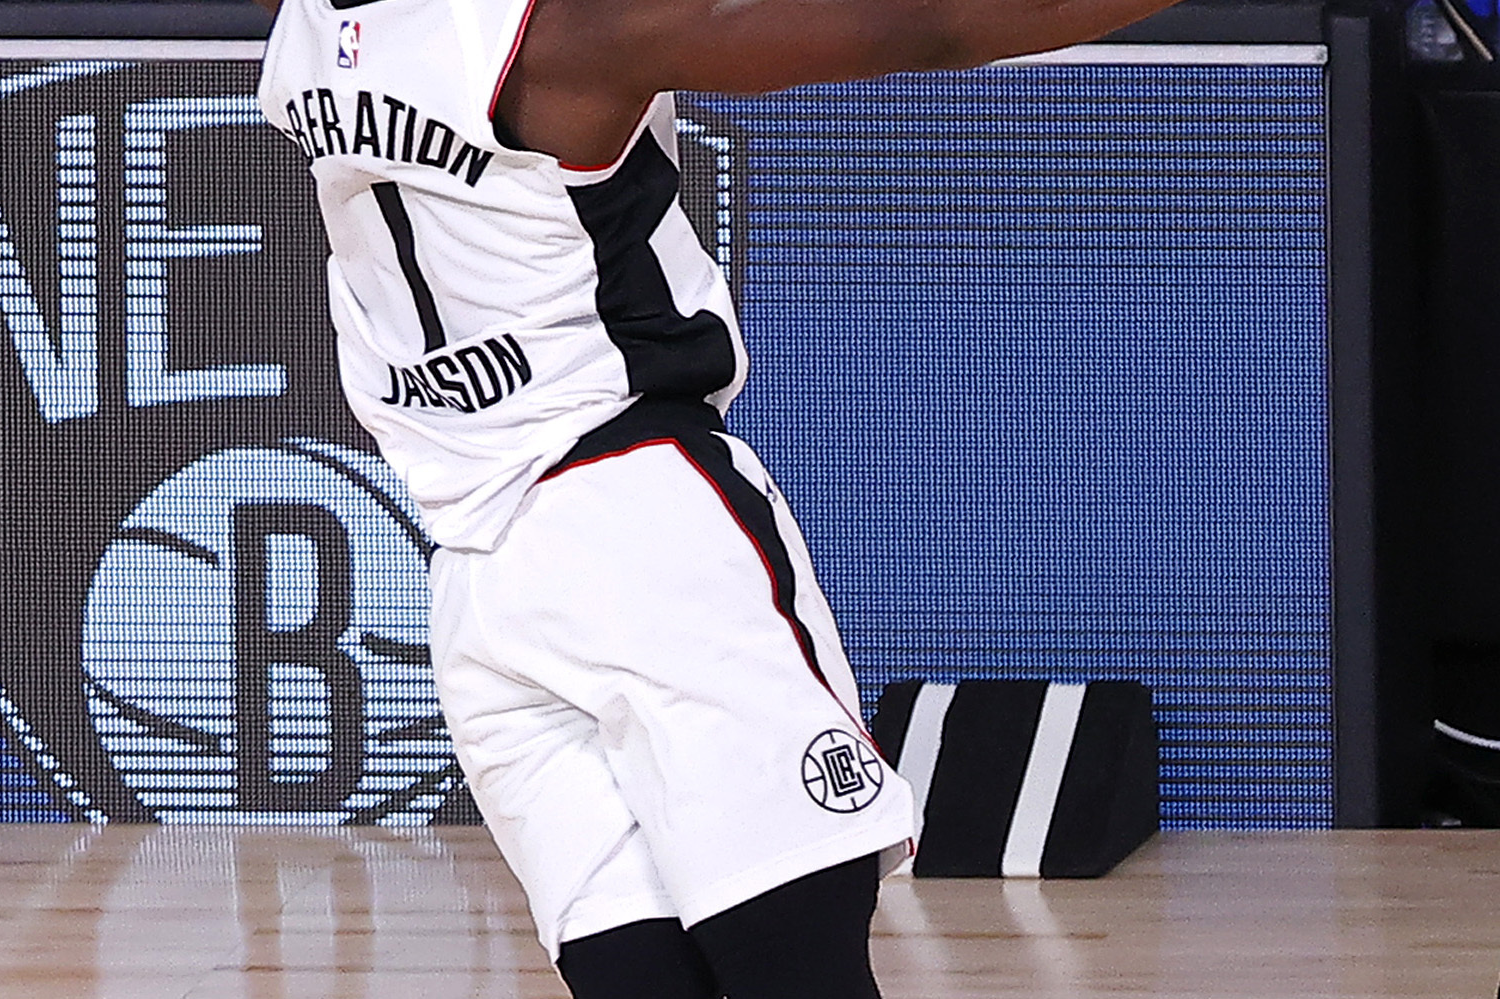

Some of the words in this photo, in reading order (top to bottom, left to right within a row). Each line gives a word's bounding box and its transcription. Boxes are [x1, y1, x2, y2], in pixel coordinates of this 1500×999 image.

[284, 87, 495, 188] BERATION
[369, 180, 448, 356] 1
[235, 503, 363, 811] B
